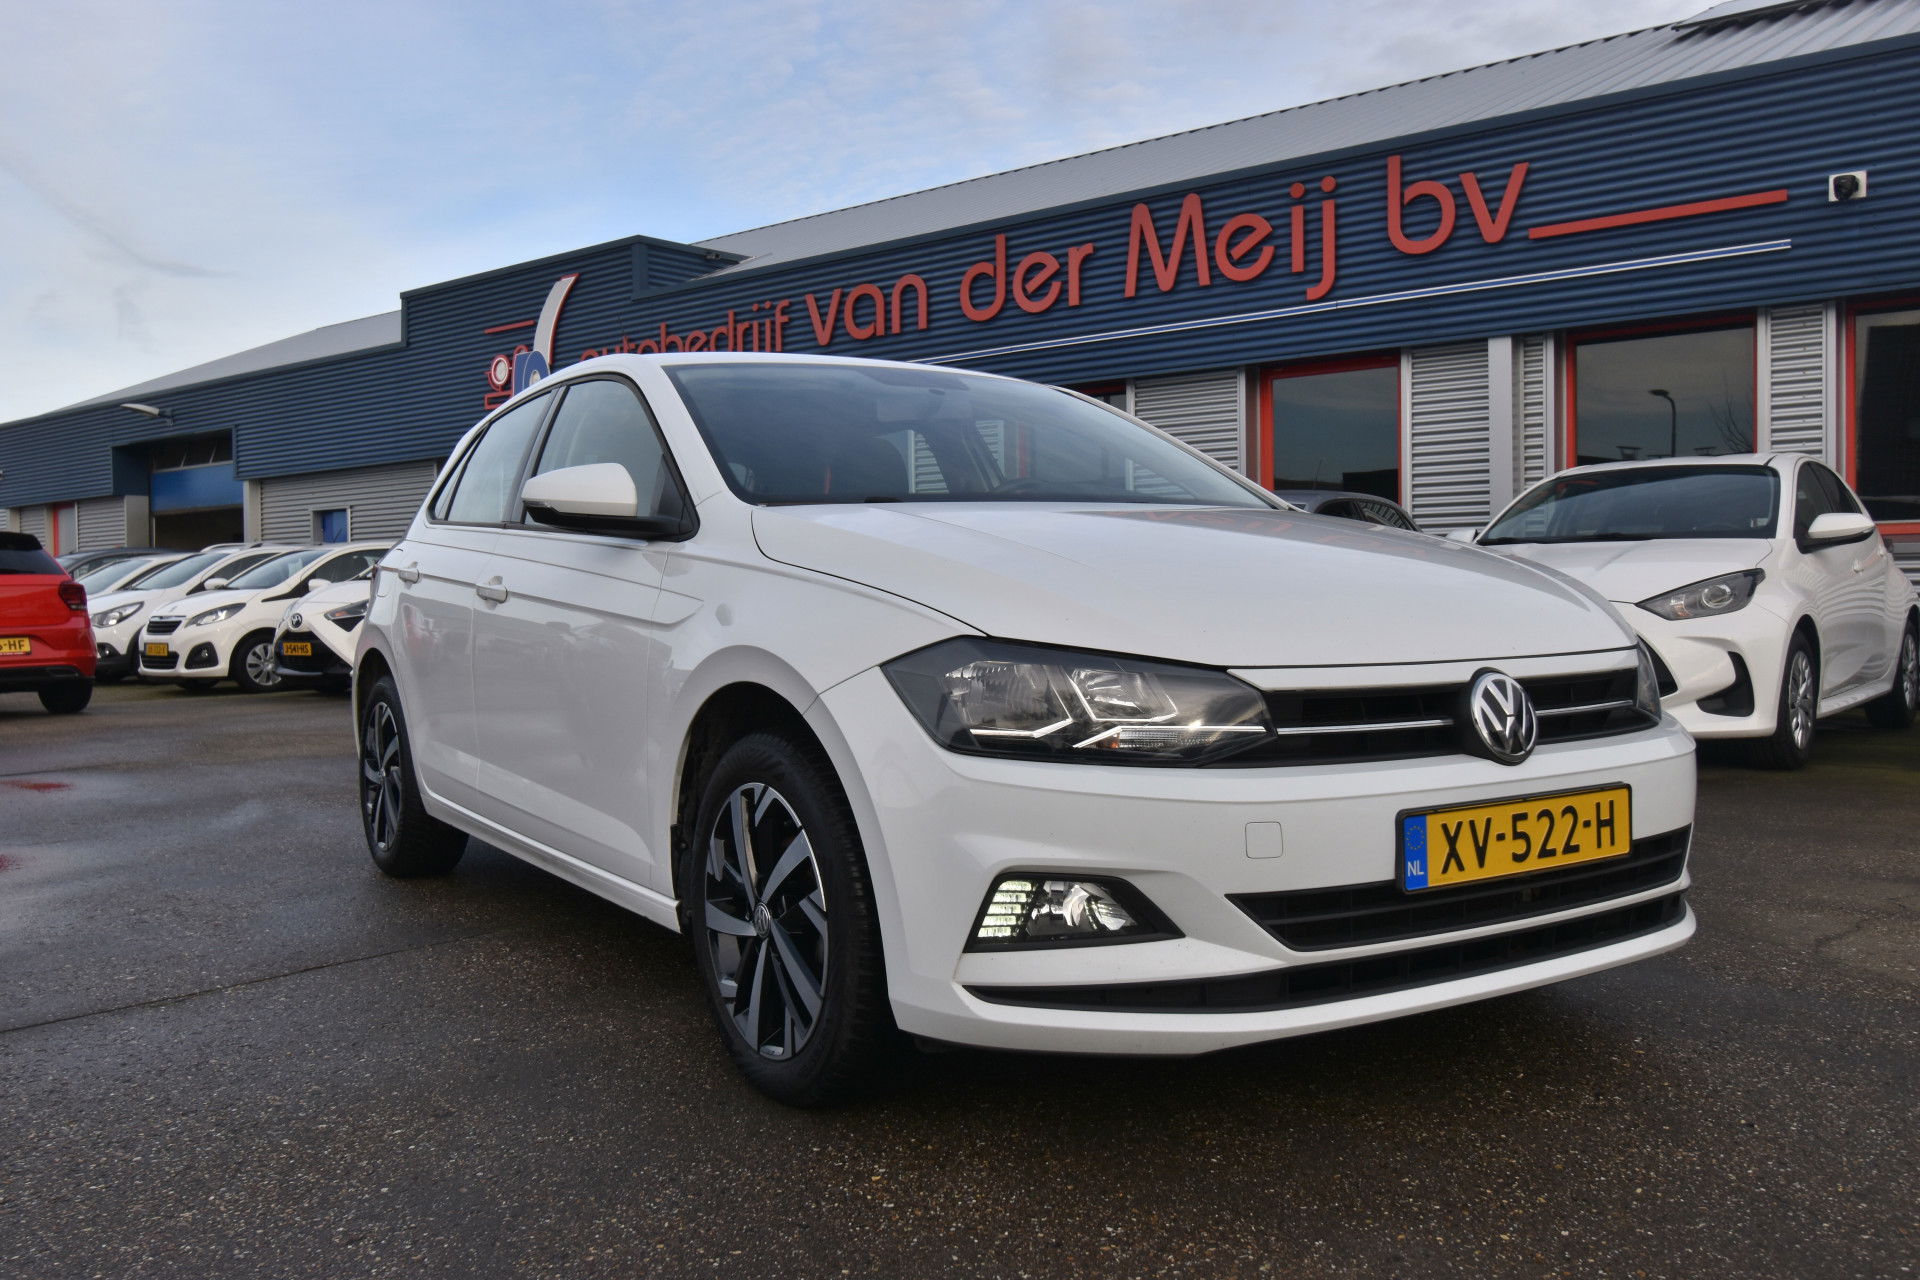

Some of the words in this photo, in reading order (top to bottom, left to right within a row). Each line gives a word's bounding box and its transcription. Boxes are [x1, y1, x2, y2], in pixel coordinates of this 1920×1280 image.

[580, 299, 790, 362] bedrijf
[805, 273, 929, 346] van
[959, 233, 1095, 322] der
[1124, 175, 1337, 300] Meij
[1386, 154, 1530, 255] bv
[1407, 860, 1425, 877] NL
[1440, 800, 1616, 875] XV-522-H
